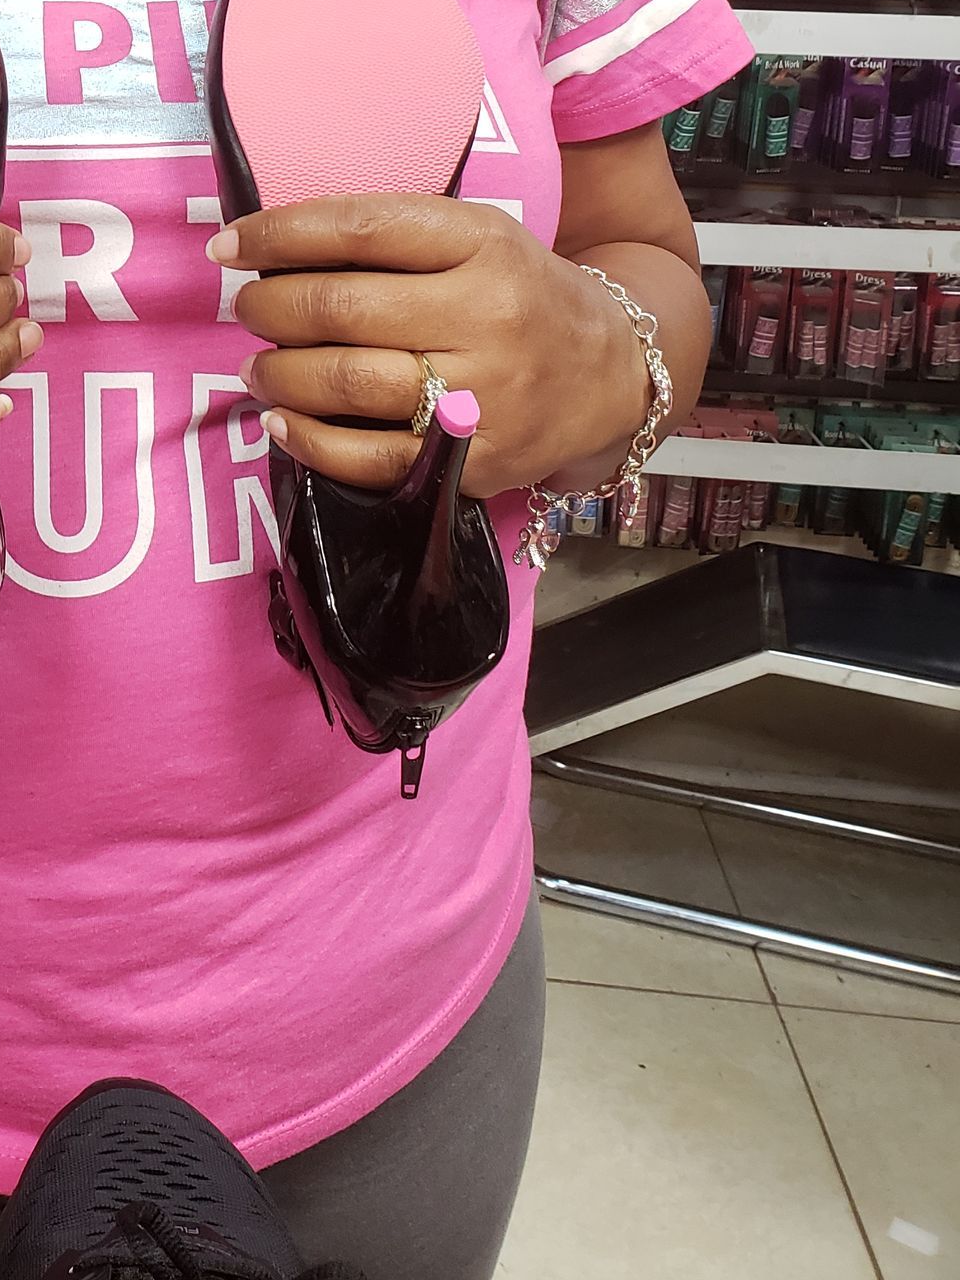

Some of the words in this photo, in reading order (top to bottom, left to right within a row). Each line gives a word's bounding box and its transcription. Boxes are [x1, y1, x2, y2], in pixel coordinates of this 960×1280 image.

[785, 60, 800, 69] Work
[850, 59, 887, 70] Casual
[803, 270, 832, 280] Dress
[855, 272, 886, 286] Dress
